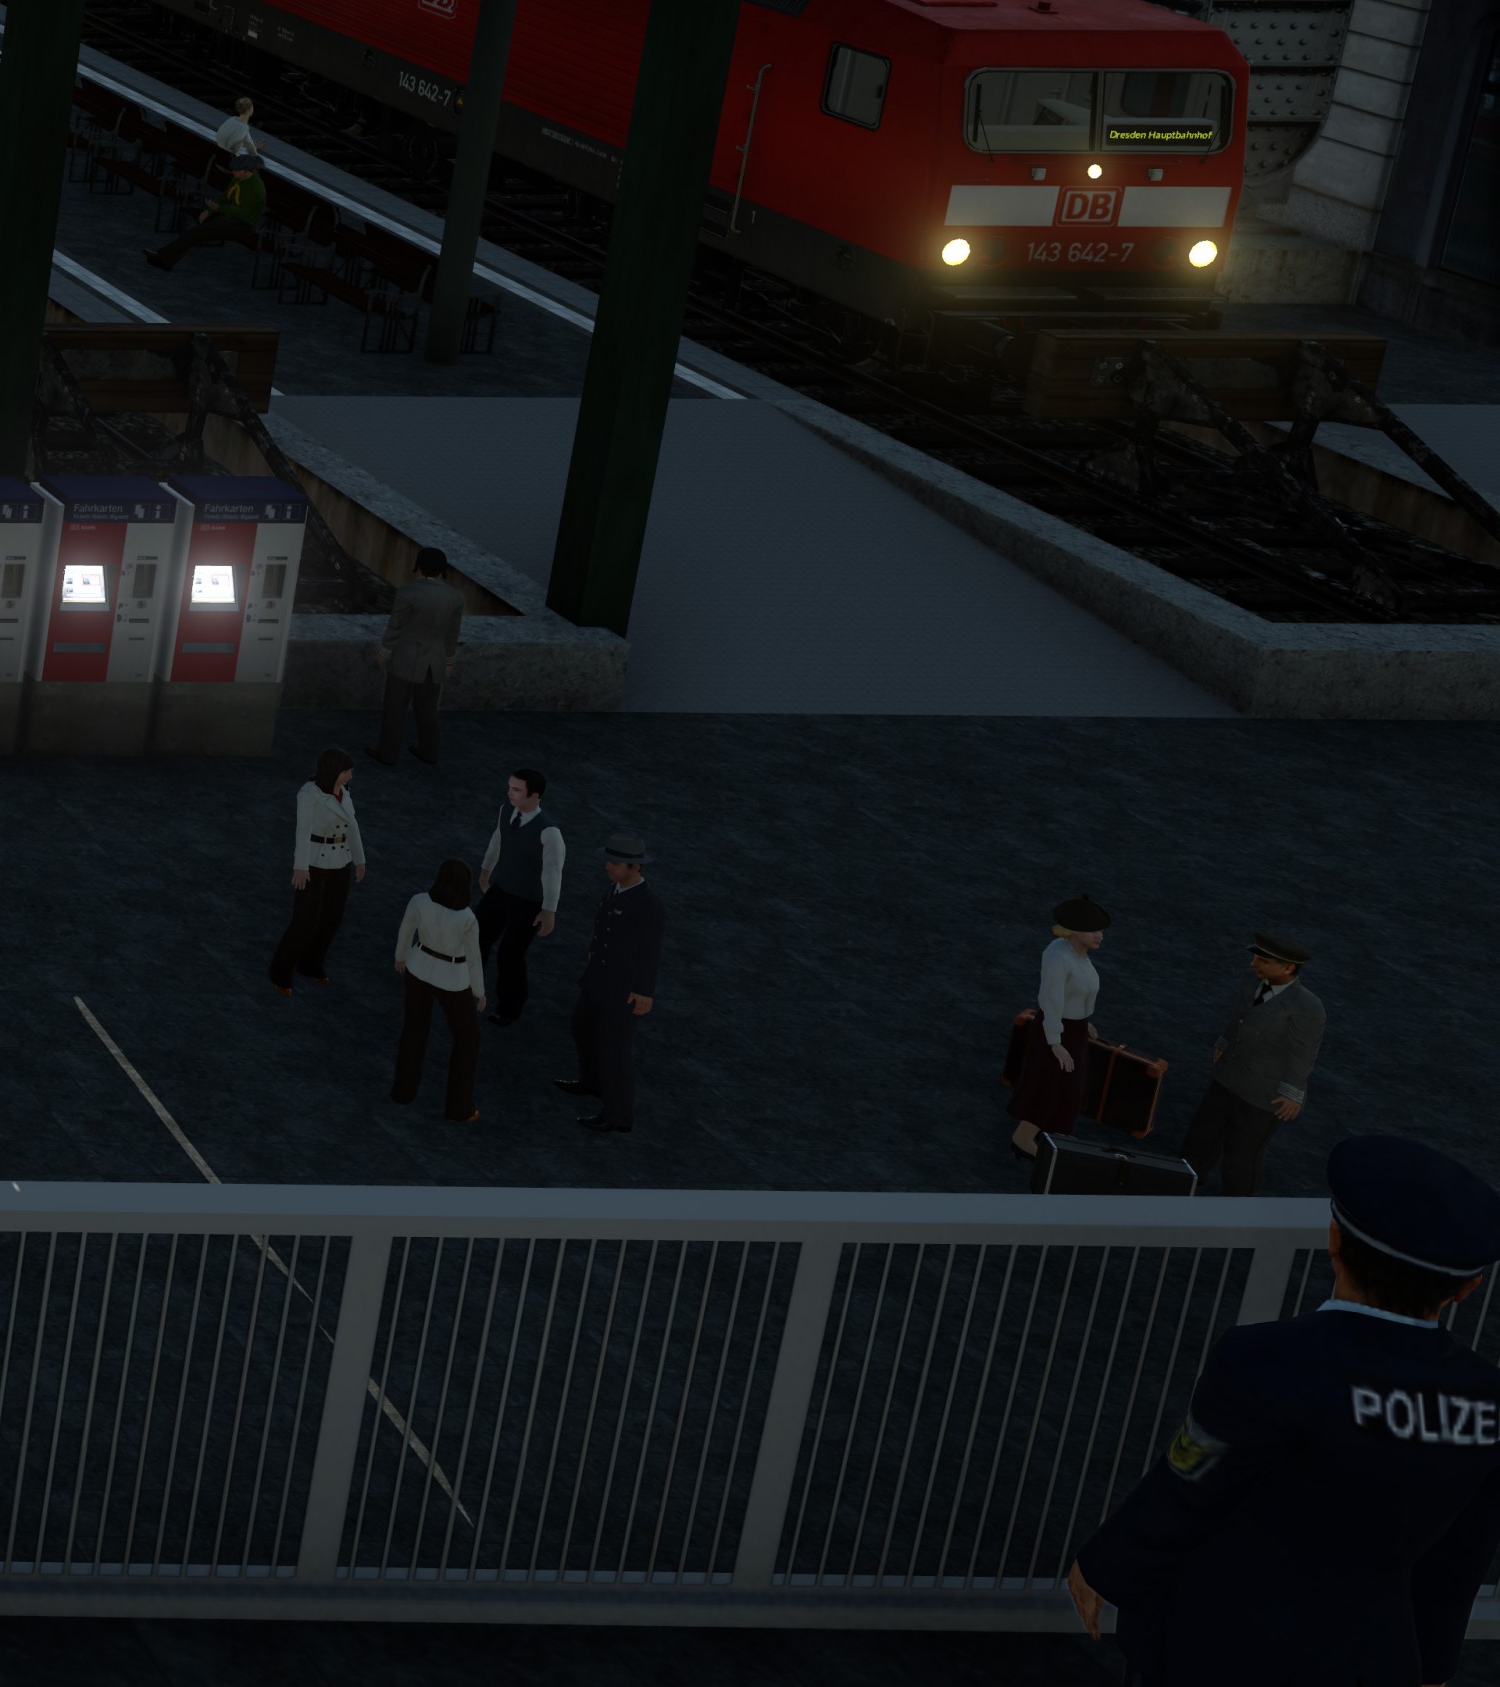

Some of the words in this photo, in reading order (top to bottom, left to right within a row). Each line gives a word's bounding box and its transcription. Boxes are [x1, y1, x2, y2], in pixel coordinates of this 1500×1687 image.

[1109, 129, 1146, 140] Dresden
[1148, 130, 1213, 142] Hauptbahnhof
[1062, 192, 1115, 221] DB
[1027, 242, 1062, 263] 143
[1067, 242, 1135, 263] 642-7
[74, 503, 123, 513] Fahrkarten
[204, 503, 254, 513] Fahrkarten
[1350, 1383, 1500, 1446] POLIZE
